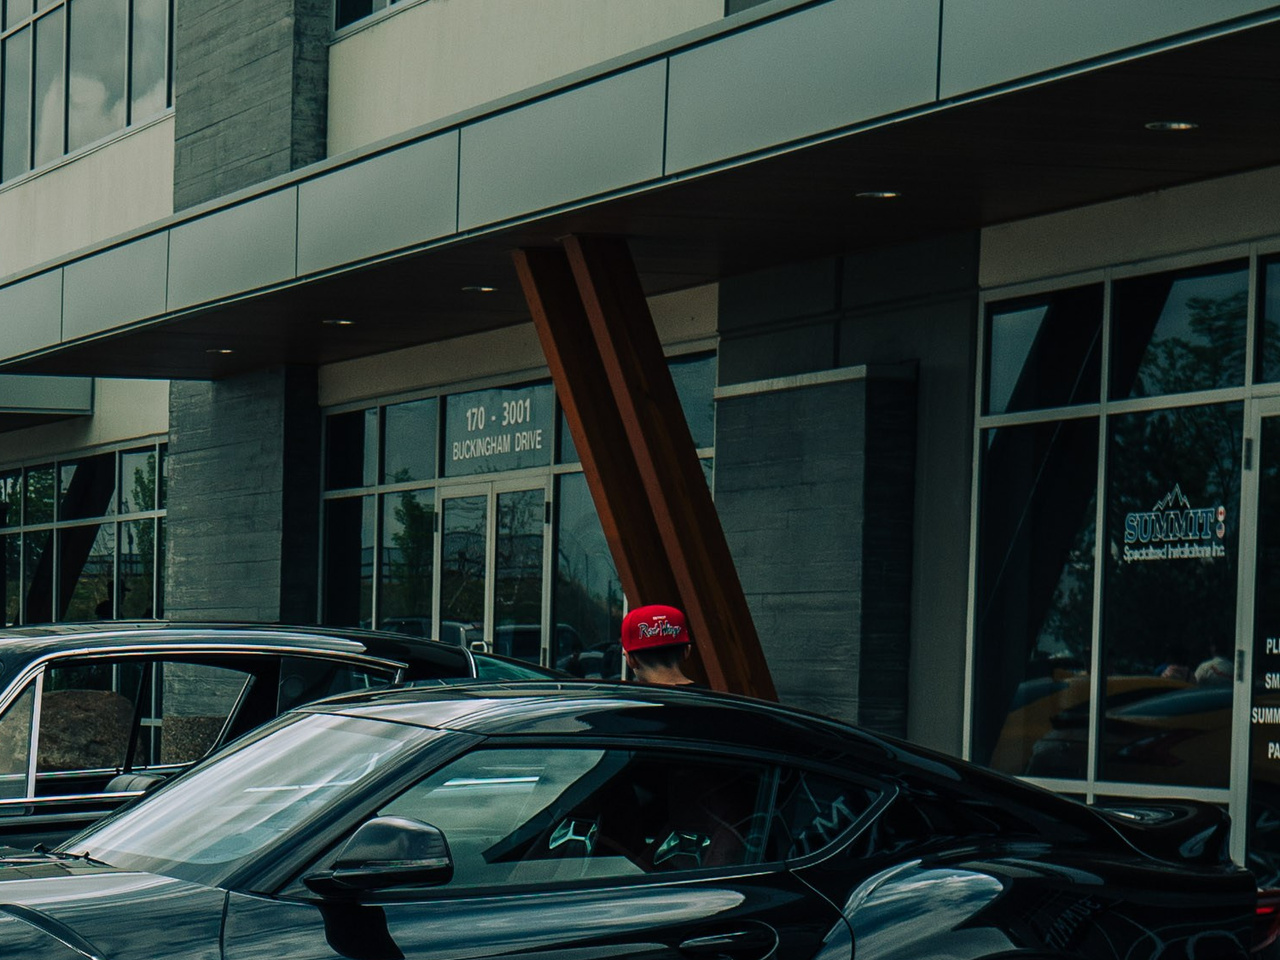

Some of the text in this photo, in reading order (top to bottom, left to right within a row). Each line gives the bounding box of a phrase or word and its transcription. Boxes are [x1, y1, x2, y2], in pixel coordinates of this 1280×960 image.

[466, 406, 485, 431] 170
[502, 398, 530, 426] 3001
[453, 429, 542, 460] BUCKINGHAM DRIVE
[1124, 508, 1214, 543] SUMMIT
[1265, 673, 1280, 689] SM
